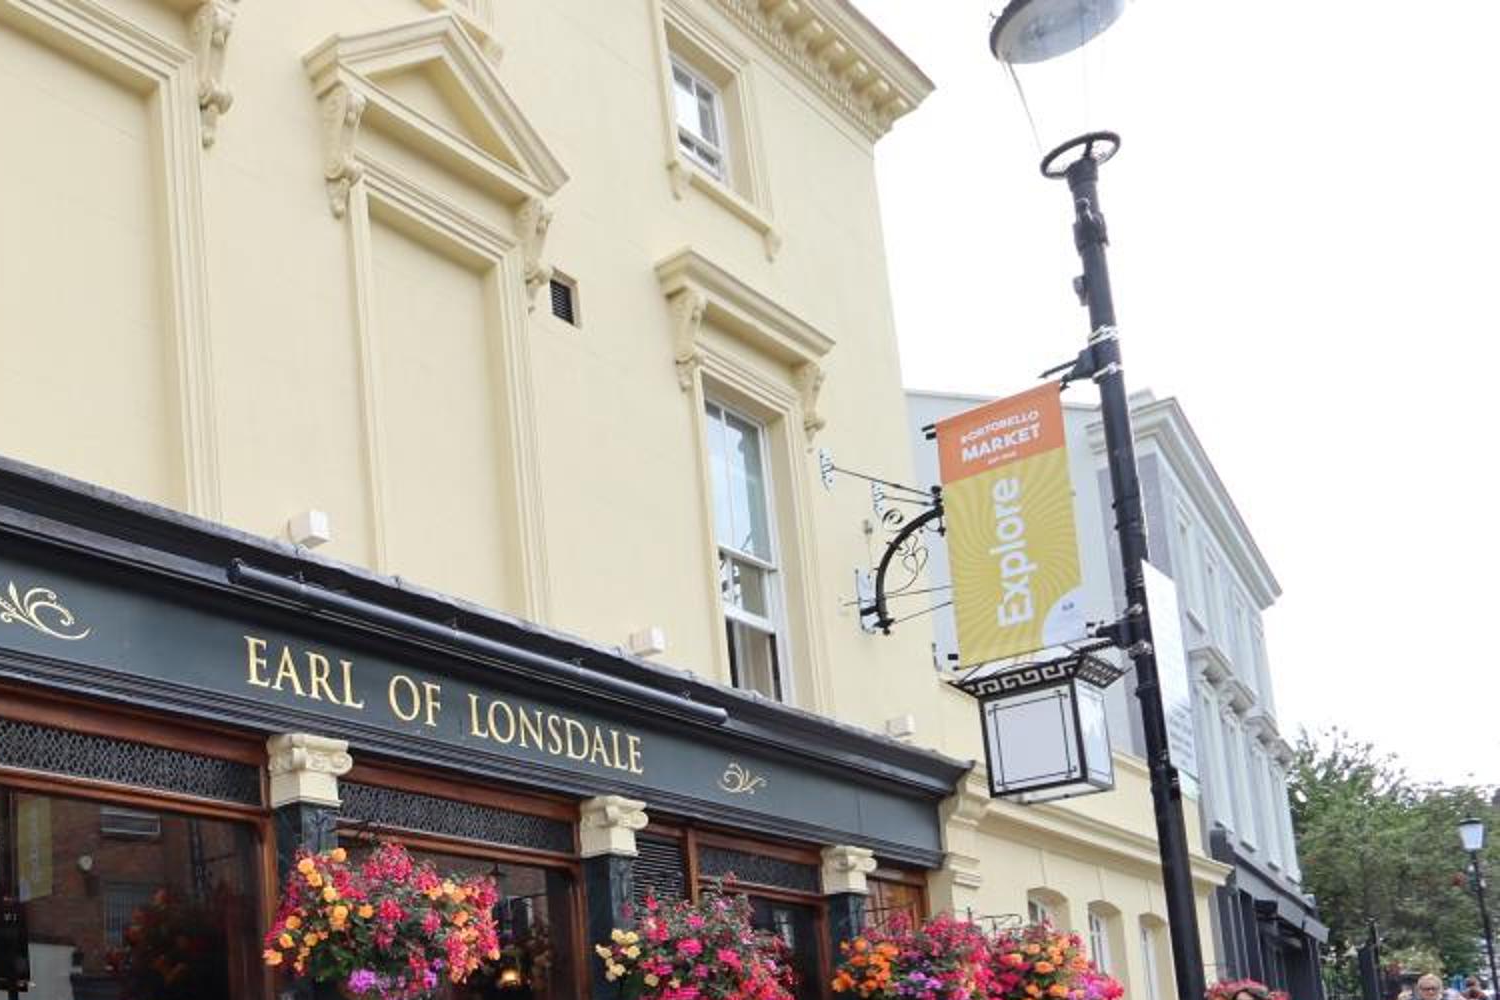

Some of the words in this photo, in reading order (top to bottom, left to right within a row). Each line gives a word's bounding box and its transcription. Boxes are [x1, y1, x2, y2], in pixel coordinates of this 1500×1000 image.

[960, 410, 1039, 444] PORTOBELLO
[961, 422, 1040, 464] MARKET
[989, 477, 1038, 628] Explore
[243, 635, 363, 709] EARL
[388, 675, 442, 727] OF
[467, 693, 645, 774] LONSDALE
